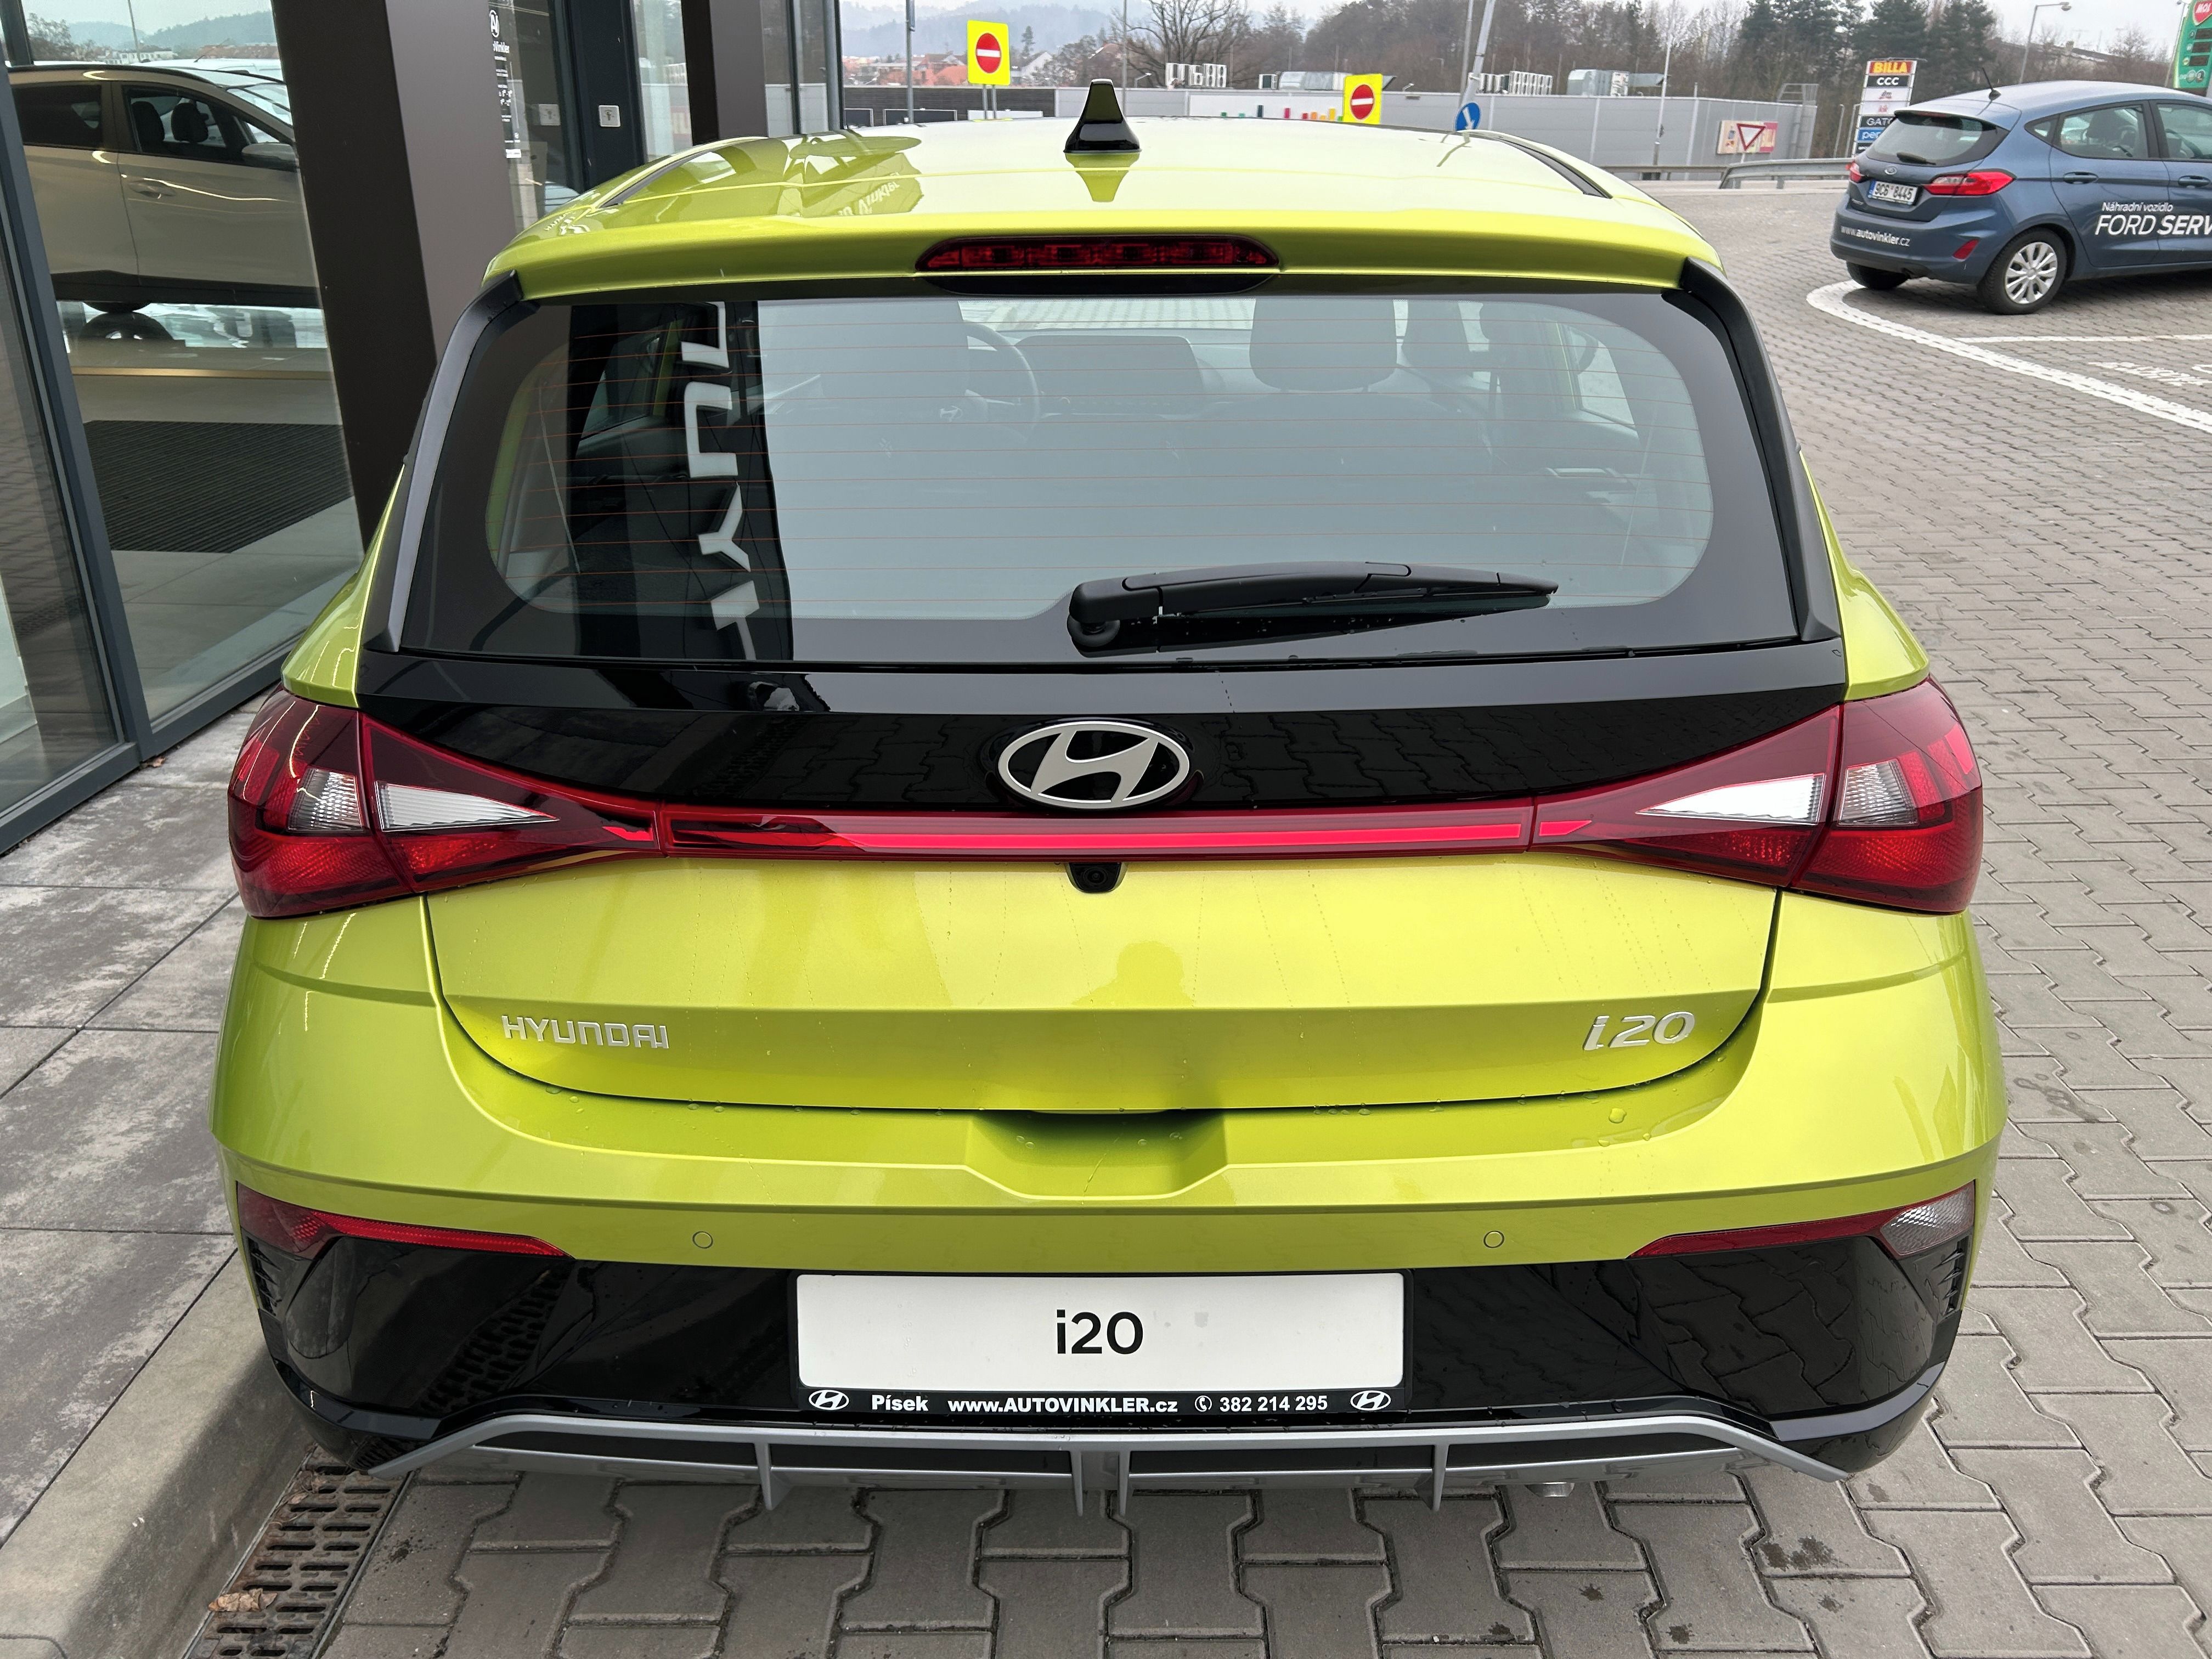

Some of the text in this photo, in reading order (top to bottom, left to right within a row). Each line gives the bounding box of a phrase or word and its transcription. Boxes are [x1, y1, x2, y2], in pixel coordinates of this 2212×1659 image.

[1873, 61, 1908, 73] BILLA
[1876, 77, 1900, 86] CCC
[2102, 202, 2174, 212] Náhradní vozidlo
[2095, 215, 2157, 235] FORD
[1841, 226, 1910, 246] www.autovinkler.cz
[501, 1015, 669, 1049] HYUNDAI
[1583, 1011, 1696, 1051] i20
[1057, 1309, 1143, 1355] i20
[872, 1395, 1328, 1413] Písek www.AUTOVINKLER.cz 382 214 295
